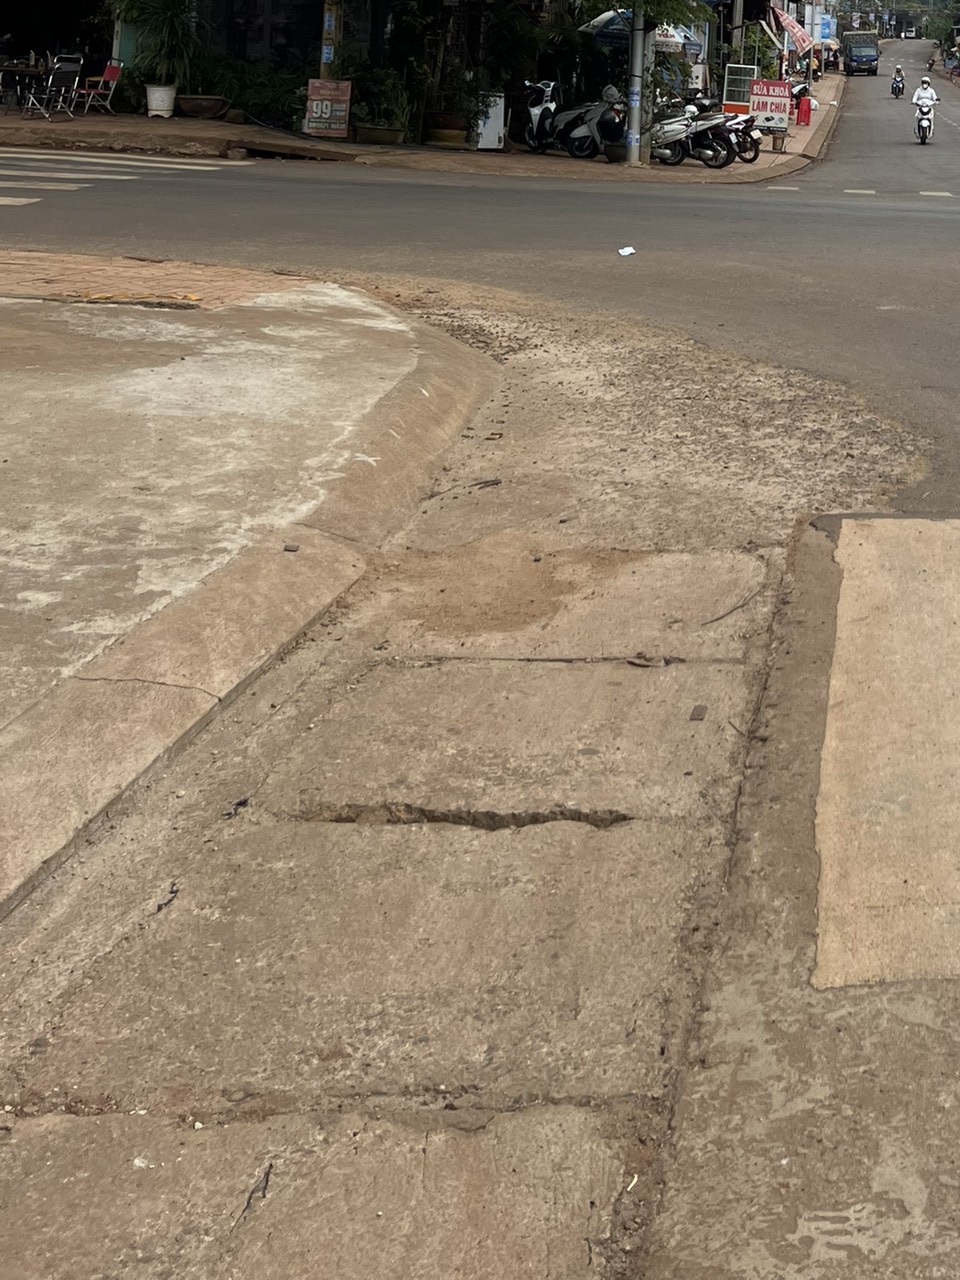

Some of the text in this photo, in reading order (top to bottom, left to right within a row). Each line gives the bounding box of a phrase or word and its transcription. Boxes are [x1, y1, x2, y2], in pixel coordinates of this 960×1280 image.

[752, 81, 789, 97] SỬA KHOÁ
[751, 98, 768, 113] LÀM
